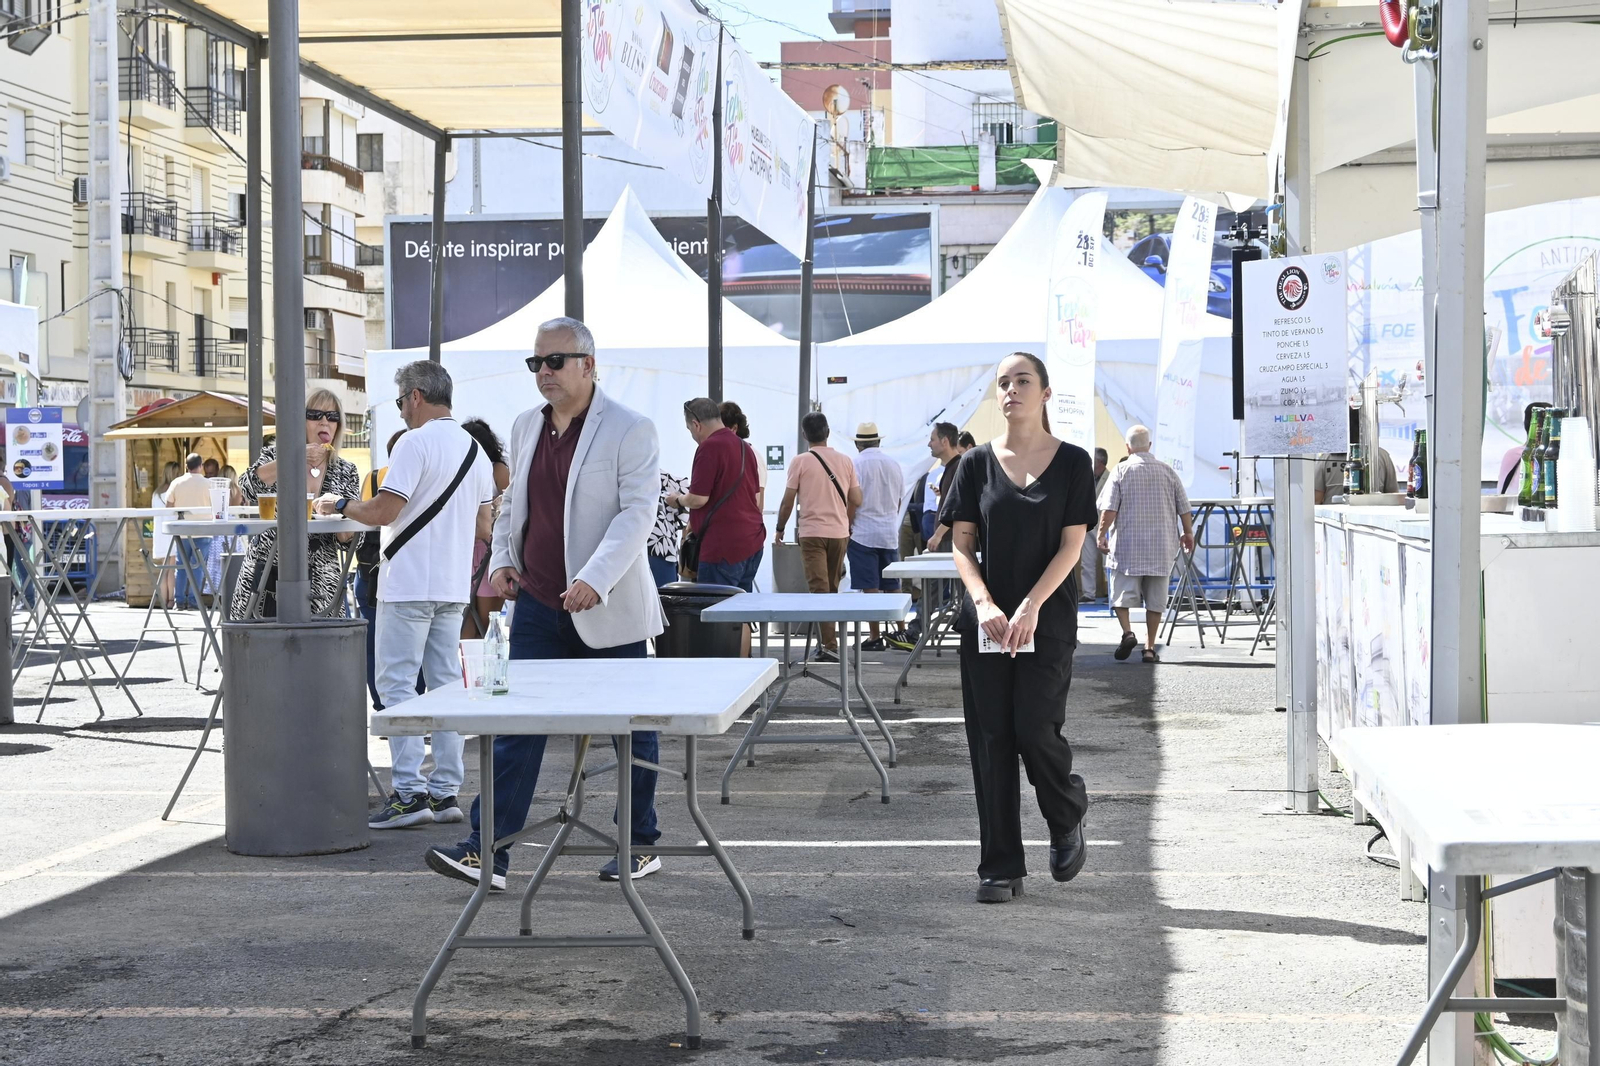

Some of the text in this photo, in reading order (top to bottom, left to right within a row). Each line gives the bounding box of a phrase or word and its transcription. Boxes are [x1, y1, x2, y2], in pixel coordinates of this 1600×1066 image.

[620, 41, 647, 77] BLISS
[749, 151, 773, 185] SHOPPING
[1191, 202, 1206, 223] 28
[1076, 234, 1090, 250] 28
[471, 239, 543, 262] inspirar
[1082, 251, 1088, 266] 1
[1347, 276, 1402, 292] ndalucía
[1273, 317, 1303, 325] REFRESCO
[1262, 330, 1281, 338] TINTO
[1291, 328, 1316, 336] VERANO
[1381, 323, 1416, 338] FOE
[1276, 352, 1302, 360] CERVEZA
[1259, 364, 1295, 373] CRUZCAMPO
[1514, 344, 1549, 387] de
[1280, 387, 1299, 395] ZUMO
[1274, 414, 1315, 423] HUELVA
[62, 428, 84, 443] ola
